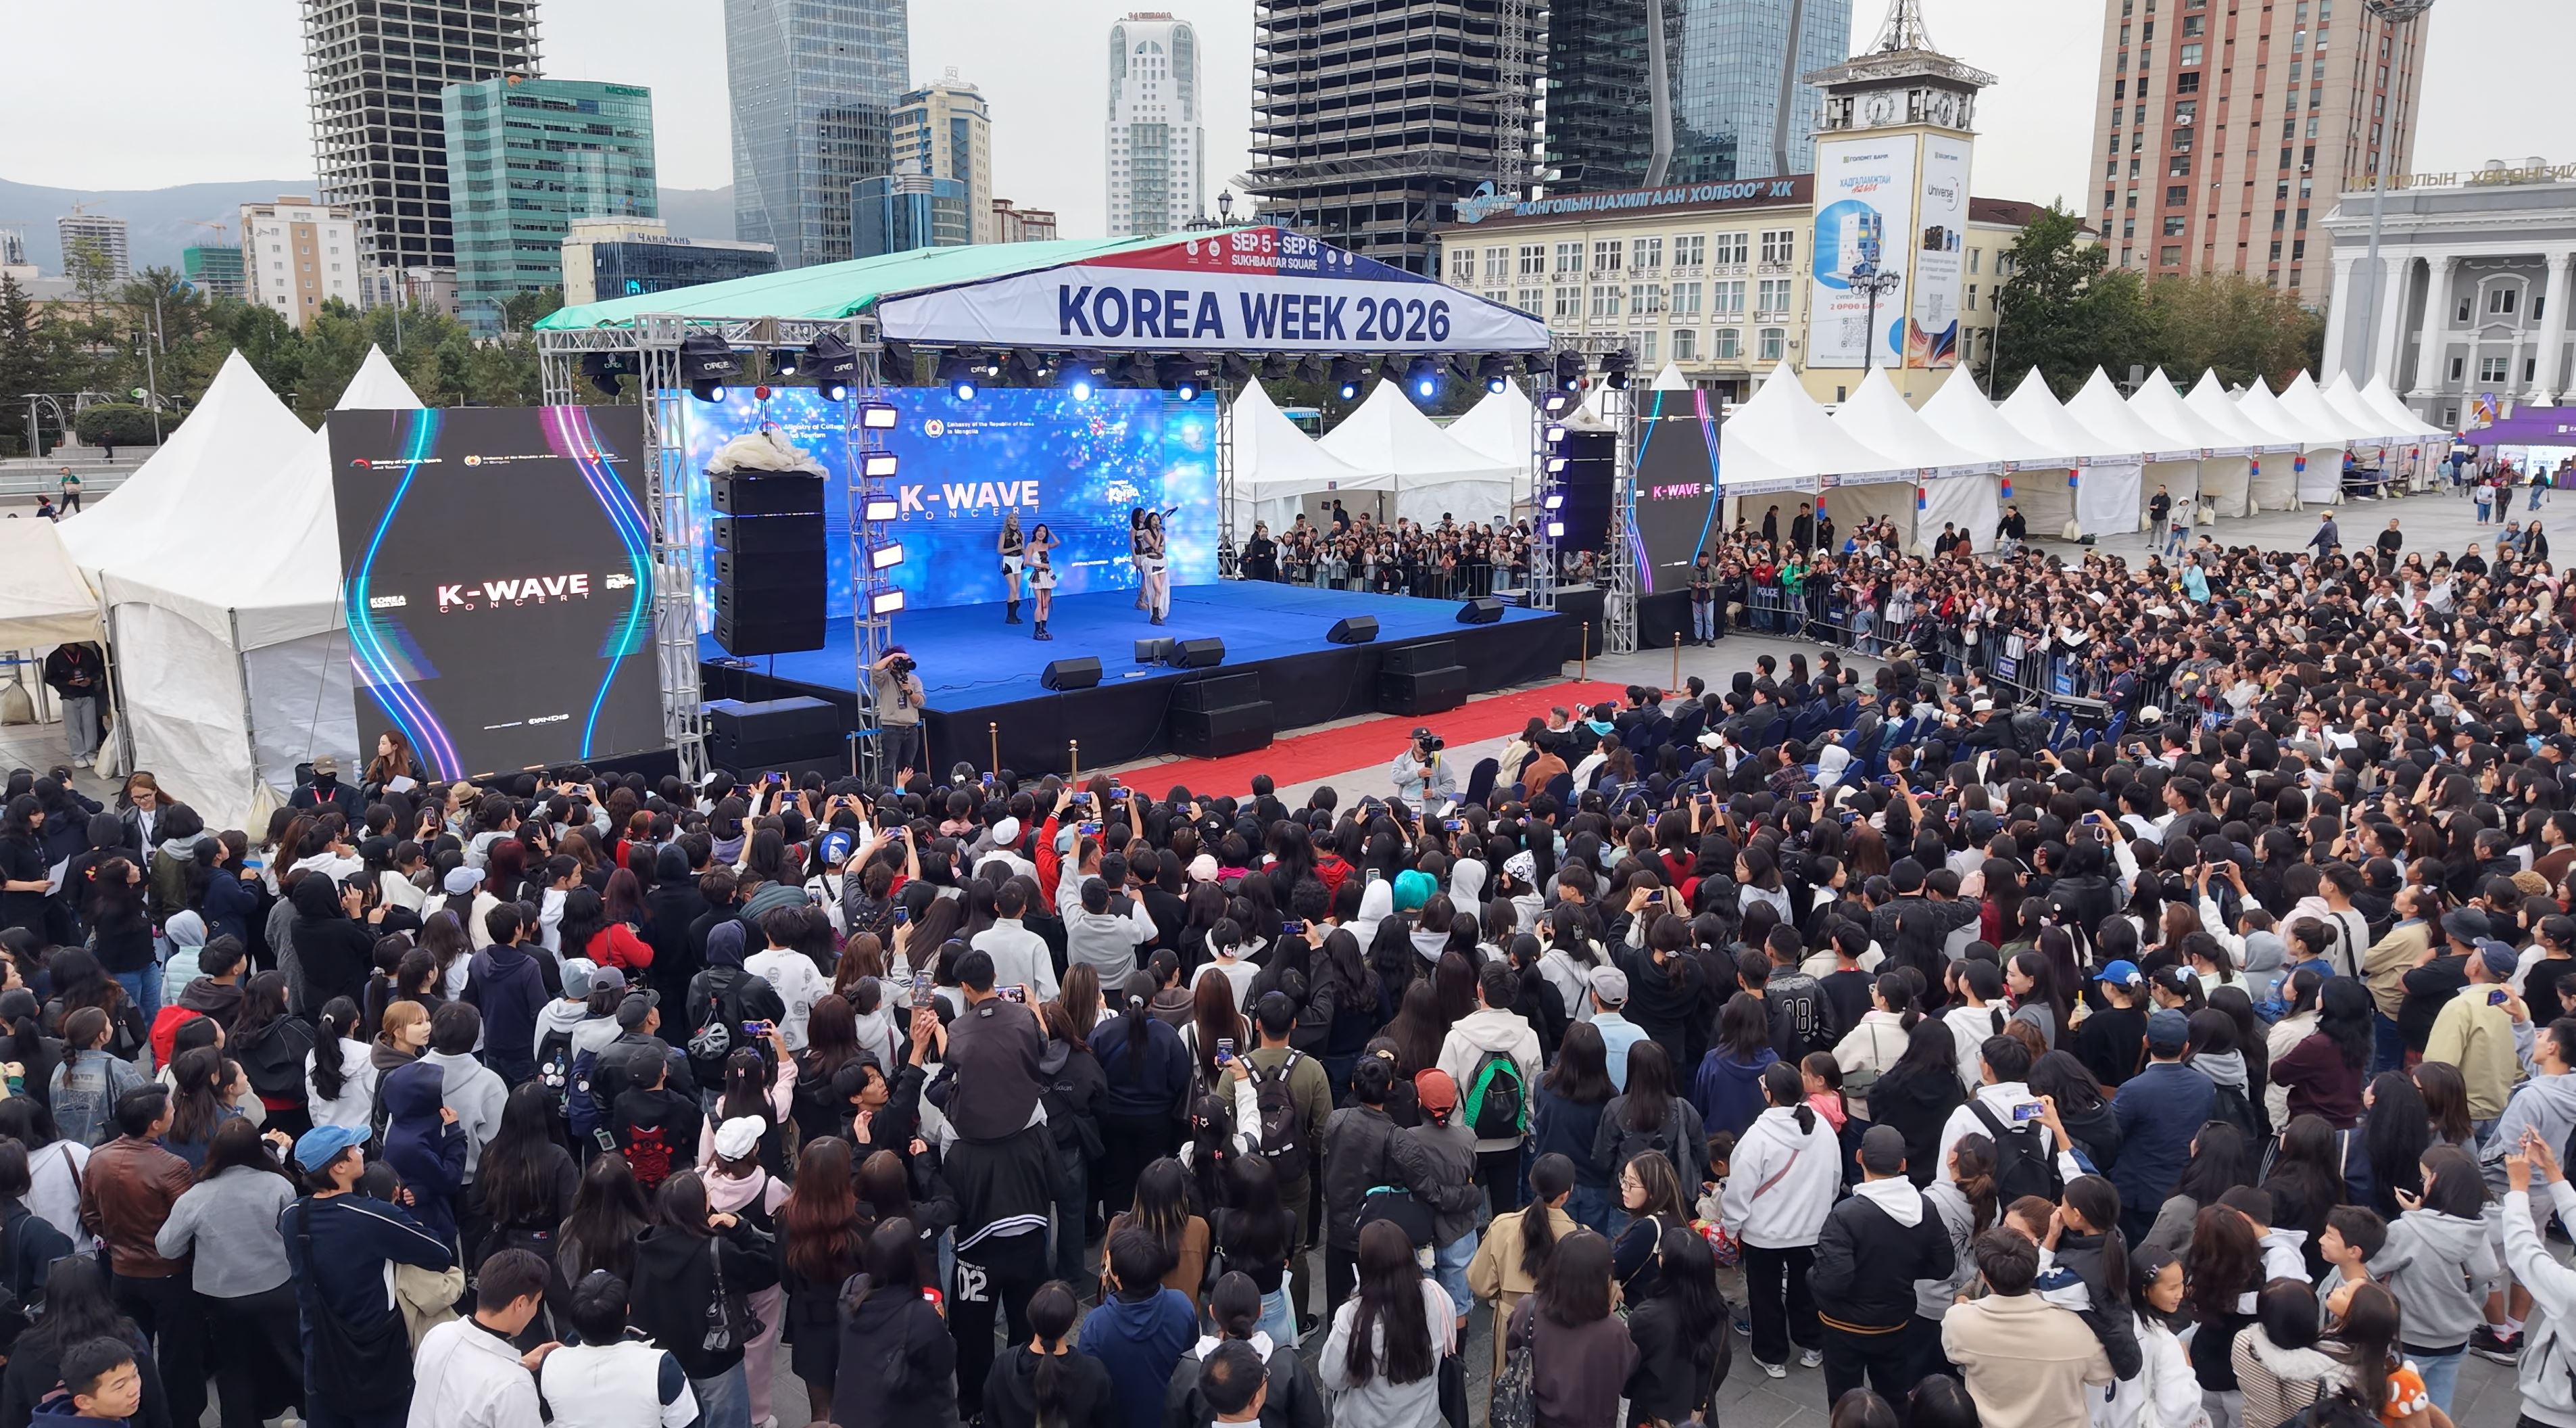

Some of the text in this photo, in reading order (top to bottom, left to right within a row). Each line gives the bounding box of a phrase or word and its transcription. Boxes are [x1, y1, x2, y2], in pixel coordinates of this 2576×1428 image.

[1595, 187, 1686, 212] ЦАХИЛГААН
[1768, 181, 1795, 197] ХК
[638, 233, 691, 245] ЧАНДМАНЬ
[1232, 233, 1258, 251] SEP
[1262, 235, 1271, 252] 5
[1282, 237, 1307, 255] SEP
[1308, 239, 1317, 256] 6
[1232, 254, 1286, 268] SUKHBAATAR
[1288, 258, 1317, 270] SQUARE
[1059, 284, 1451, 342] KOREA WEEK 2026
[900, 481, 1039, 512] K-WAVE
[1653, 483, 1700, 497] K-WAVE
[901, 506, 1040, 522] CONCERT
[370, 595, 406, 604] KOREA
[439, 574, 589, 606] K-WAVE
[1757, 586, 1778, 597] POLICE
[440, 592, 589, 614] CONCERT
[2000, 662, 2014, 674] POLICE
[957, 1265, 989, 1302] 02
